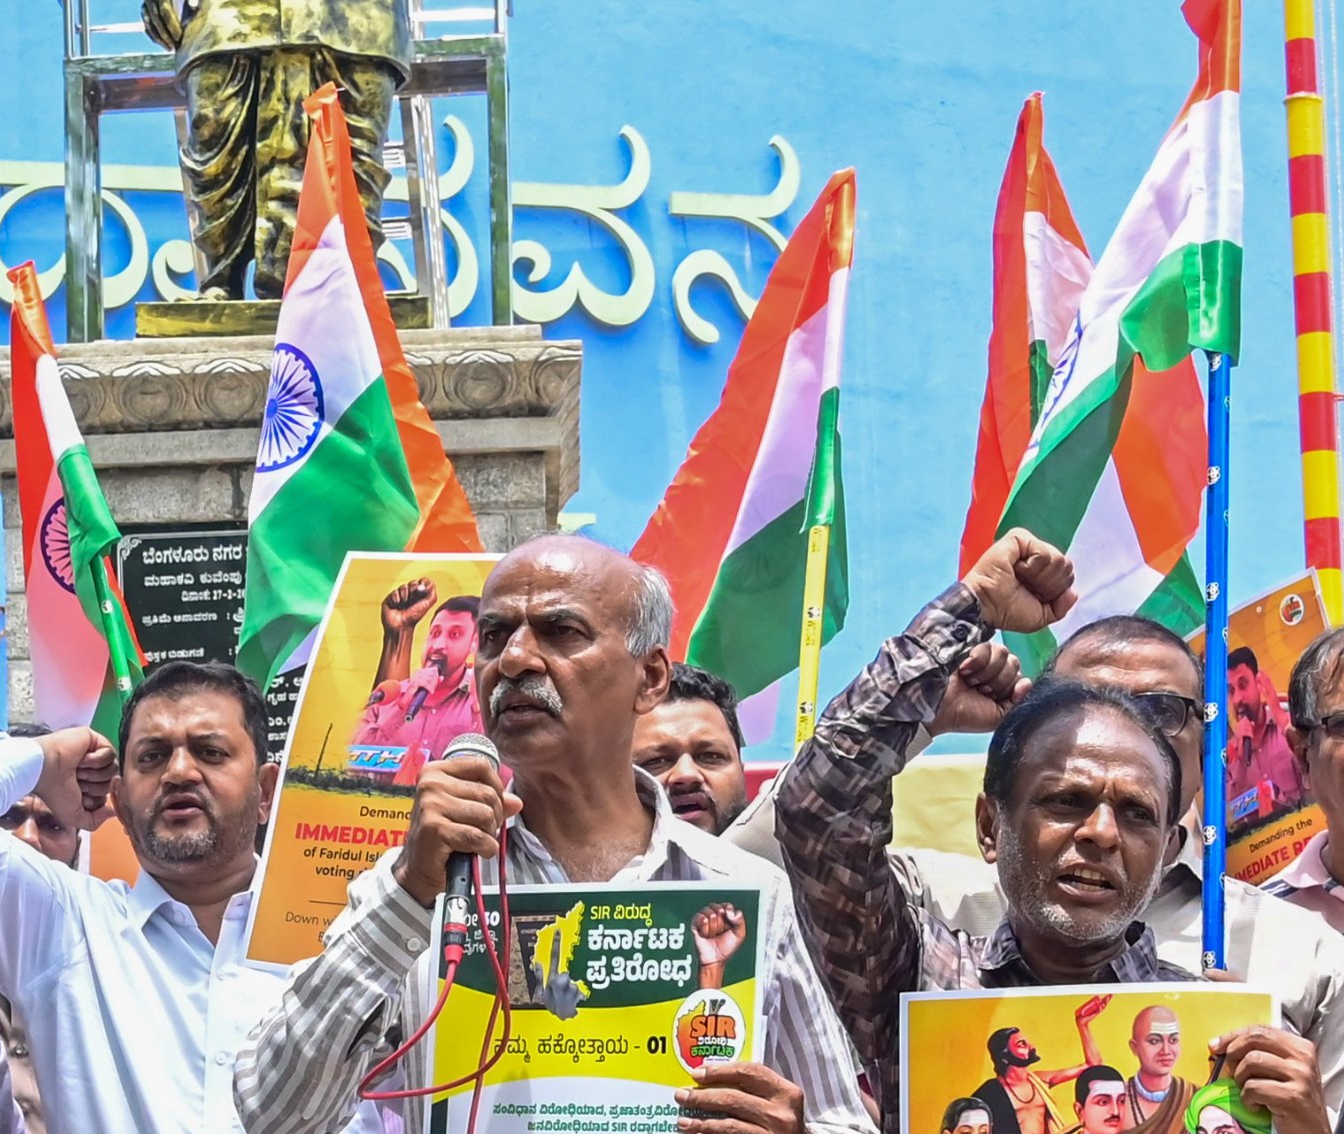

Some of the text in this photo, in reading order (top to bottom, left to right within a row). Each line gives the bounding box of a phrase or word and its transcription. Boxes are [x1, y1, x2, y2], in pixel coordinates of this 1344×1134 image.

[142, 545, 244, 565] ಬೆಂಗಳೂರು ನಗರ
[1249, 818, 1313, 853] Demanding the
[303, 848, 317, 860] of
[319, 848, 362, 863] Faridul
[315, 865, 355, 881] voting
[285, 911, 320, 926] Down
[589, 905, 611, 920] SIR
[587, 925, 685, 950] ಕರ್ನಾಟಕ
[585, 955, 692, 989] ಪ್ರತಿರೋಧ
[689, 1014, 737, 1039] SIR
